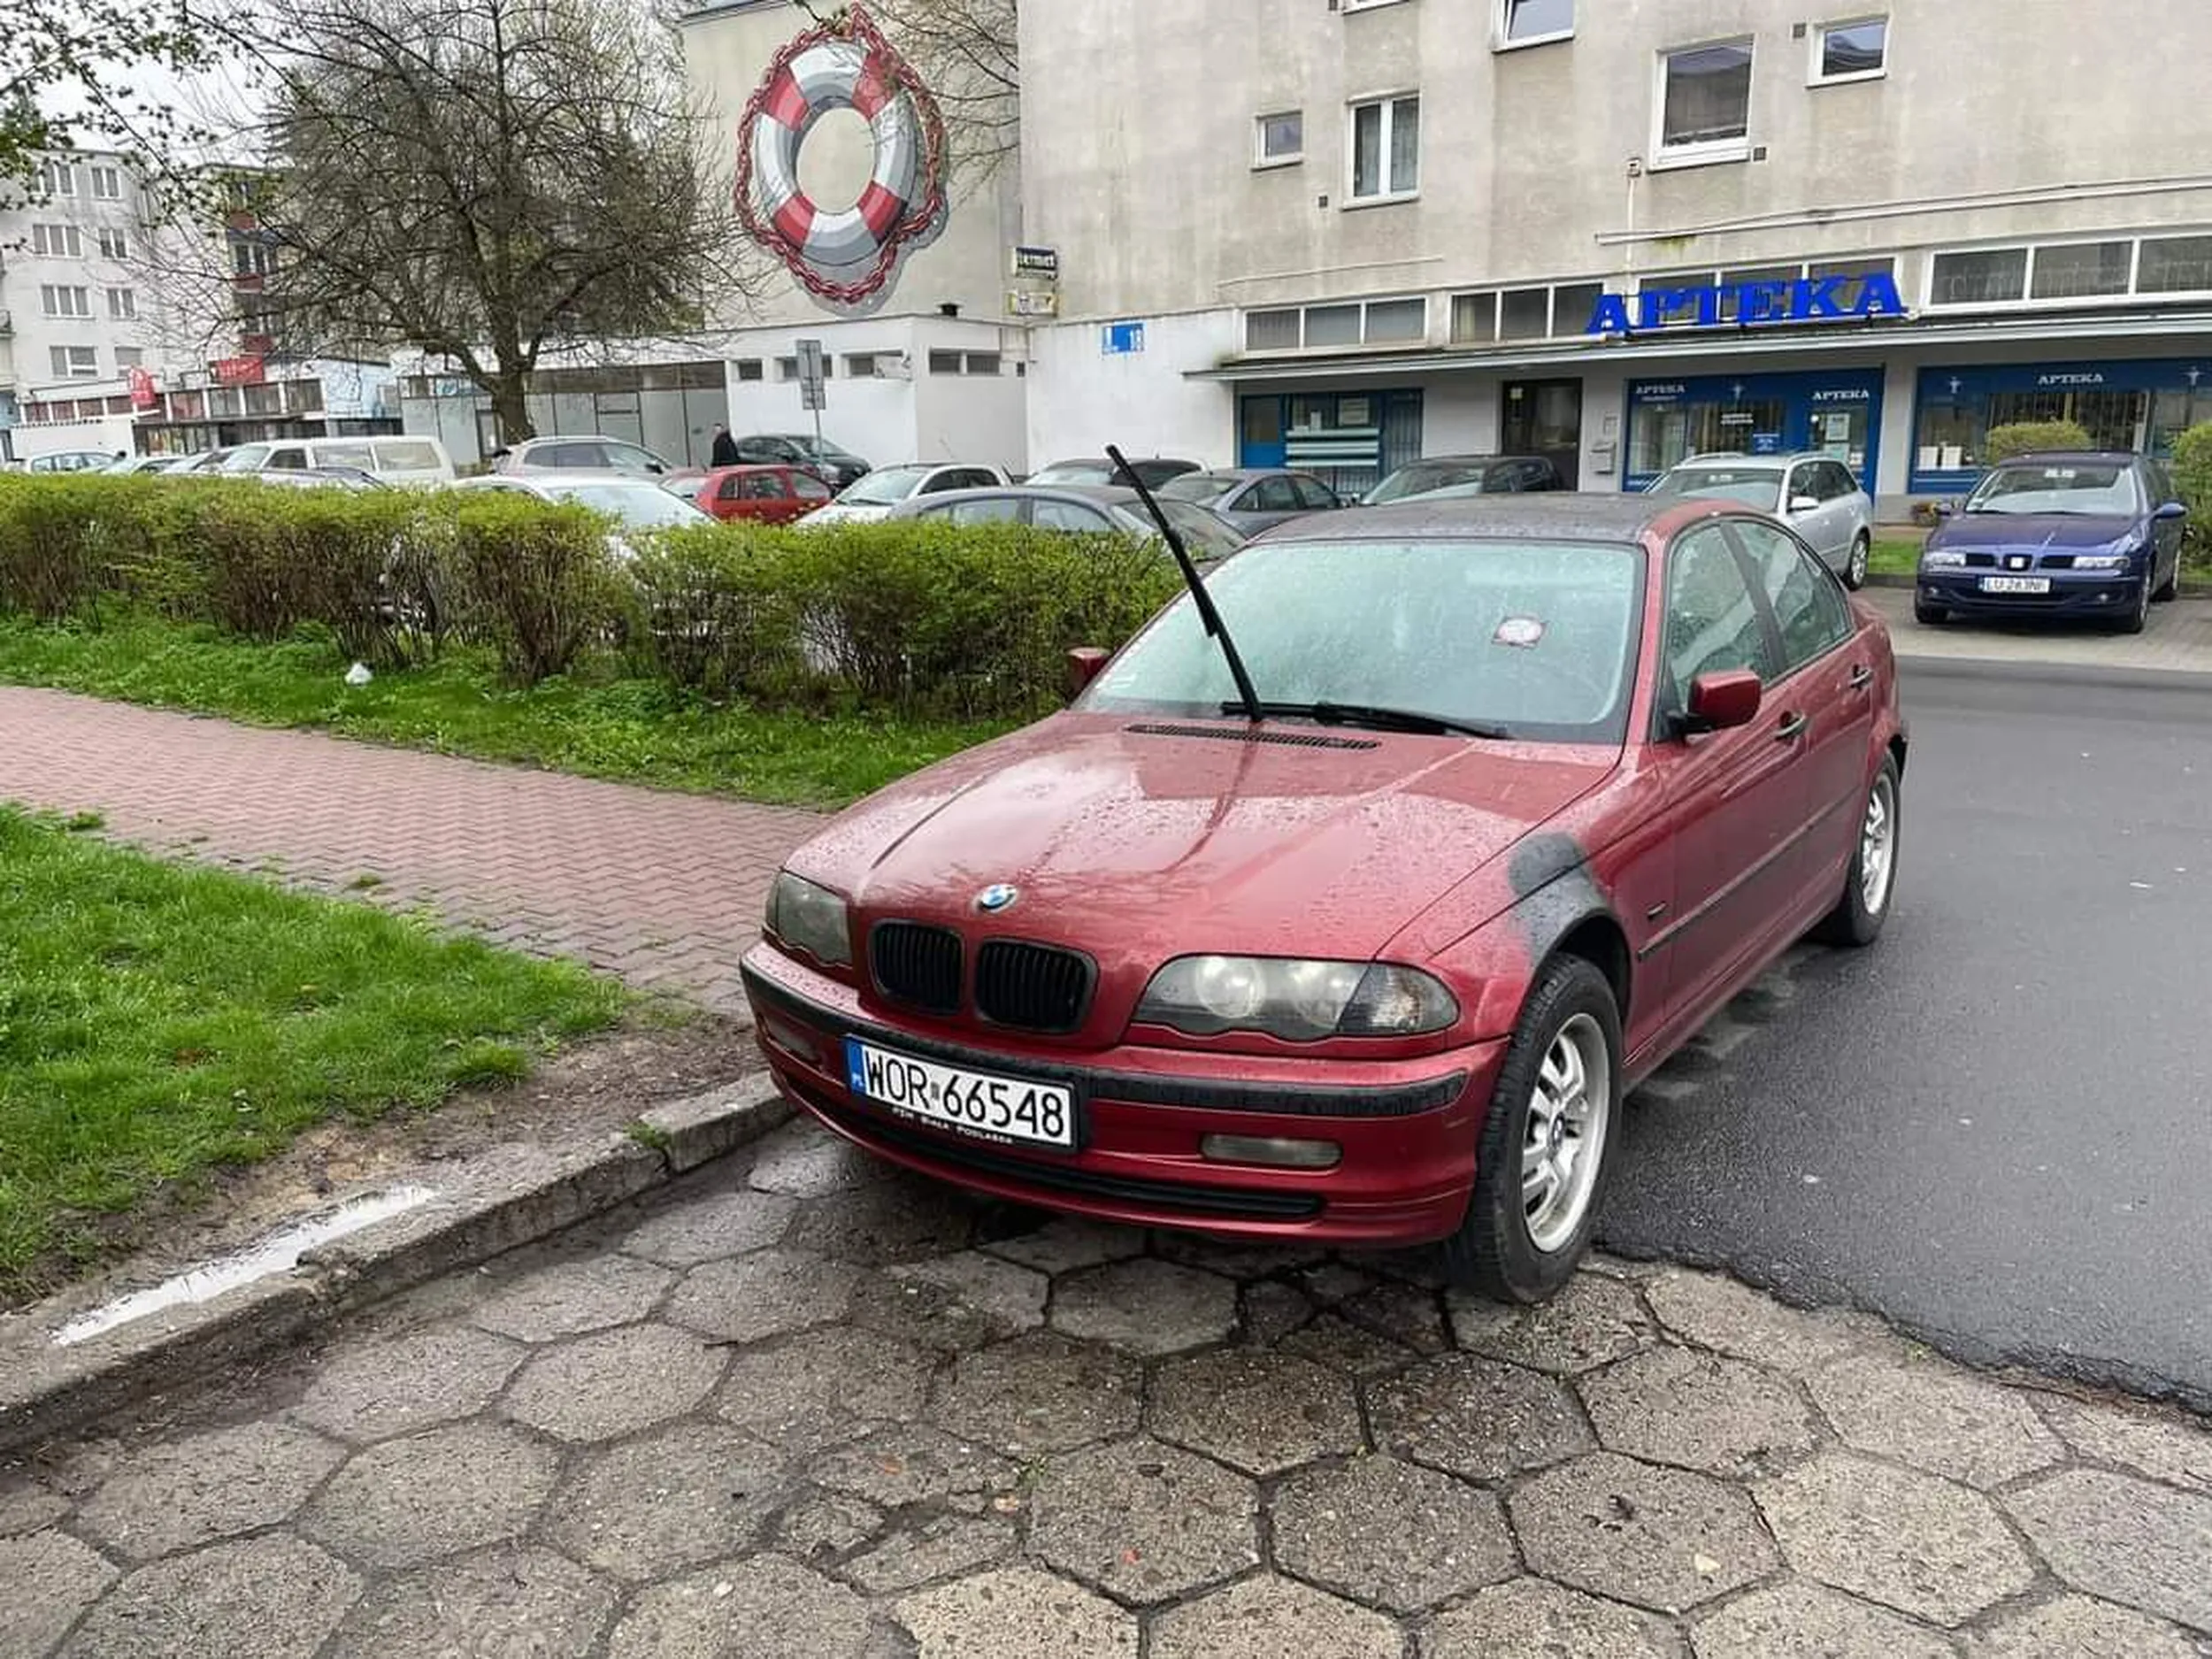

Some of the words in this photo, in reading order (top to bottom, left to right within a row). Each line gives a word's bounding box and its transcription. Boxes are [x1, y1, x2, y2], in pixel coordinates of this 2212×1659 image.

[1585, 272, 1906, 335] APTEKA
[2038, 373, 2103, 385] APTEKA
[1635, 384, 1686, 395] APTEKA
[1812, 389, 1870, 401] APTEKA
[864, 1049, 930, 1110] WOR
[942, 1074, 1064, 1139] 66548
